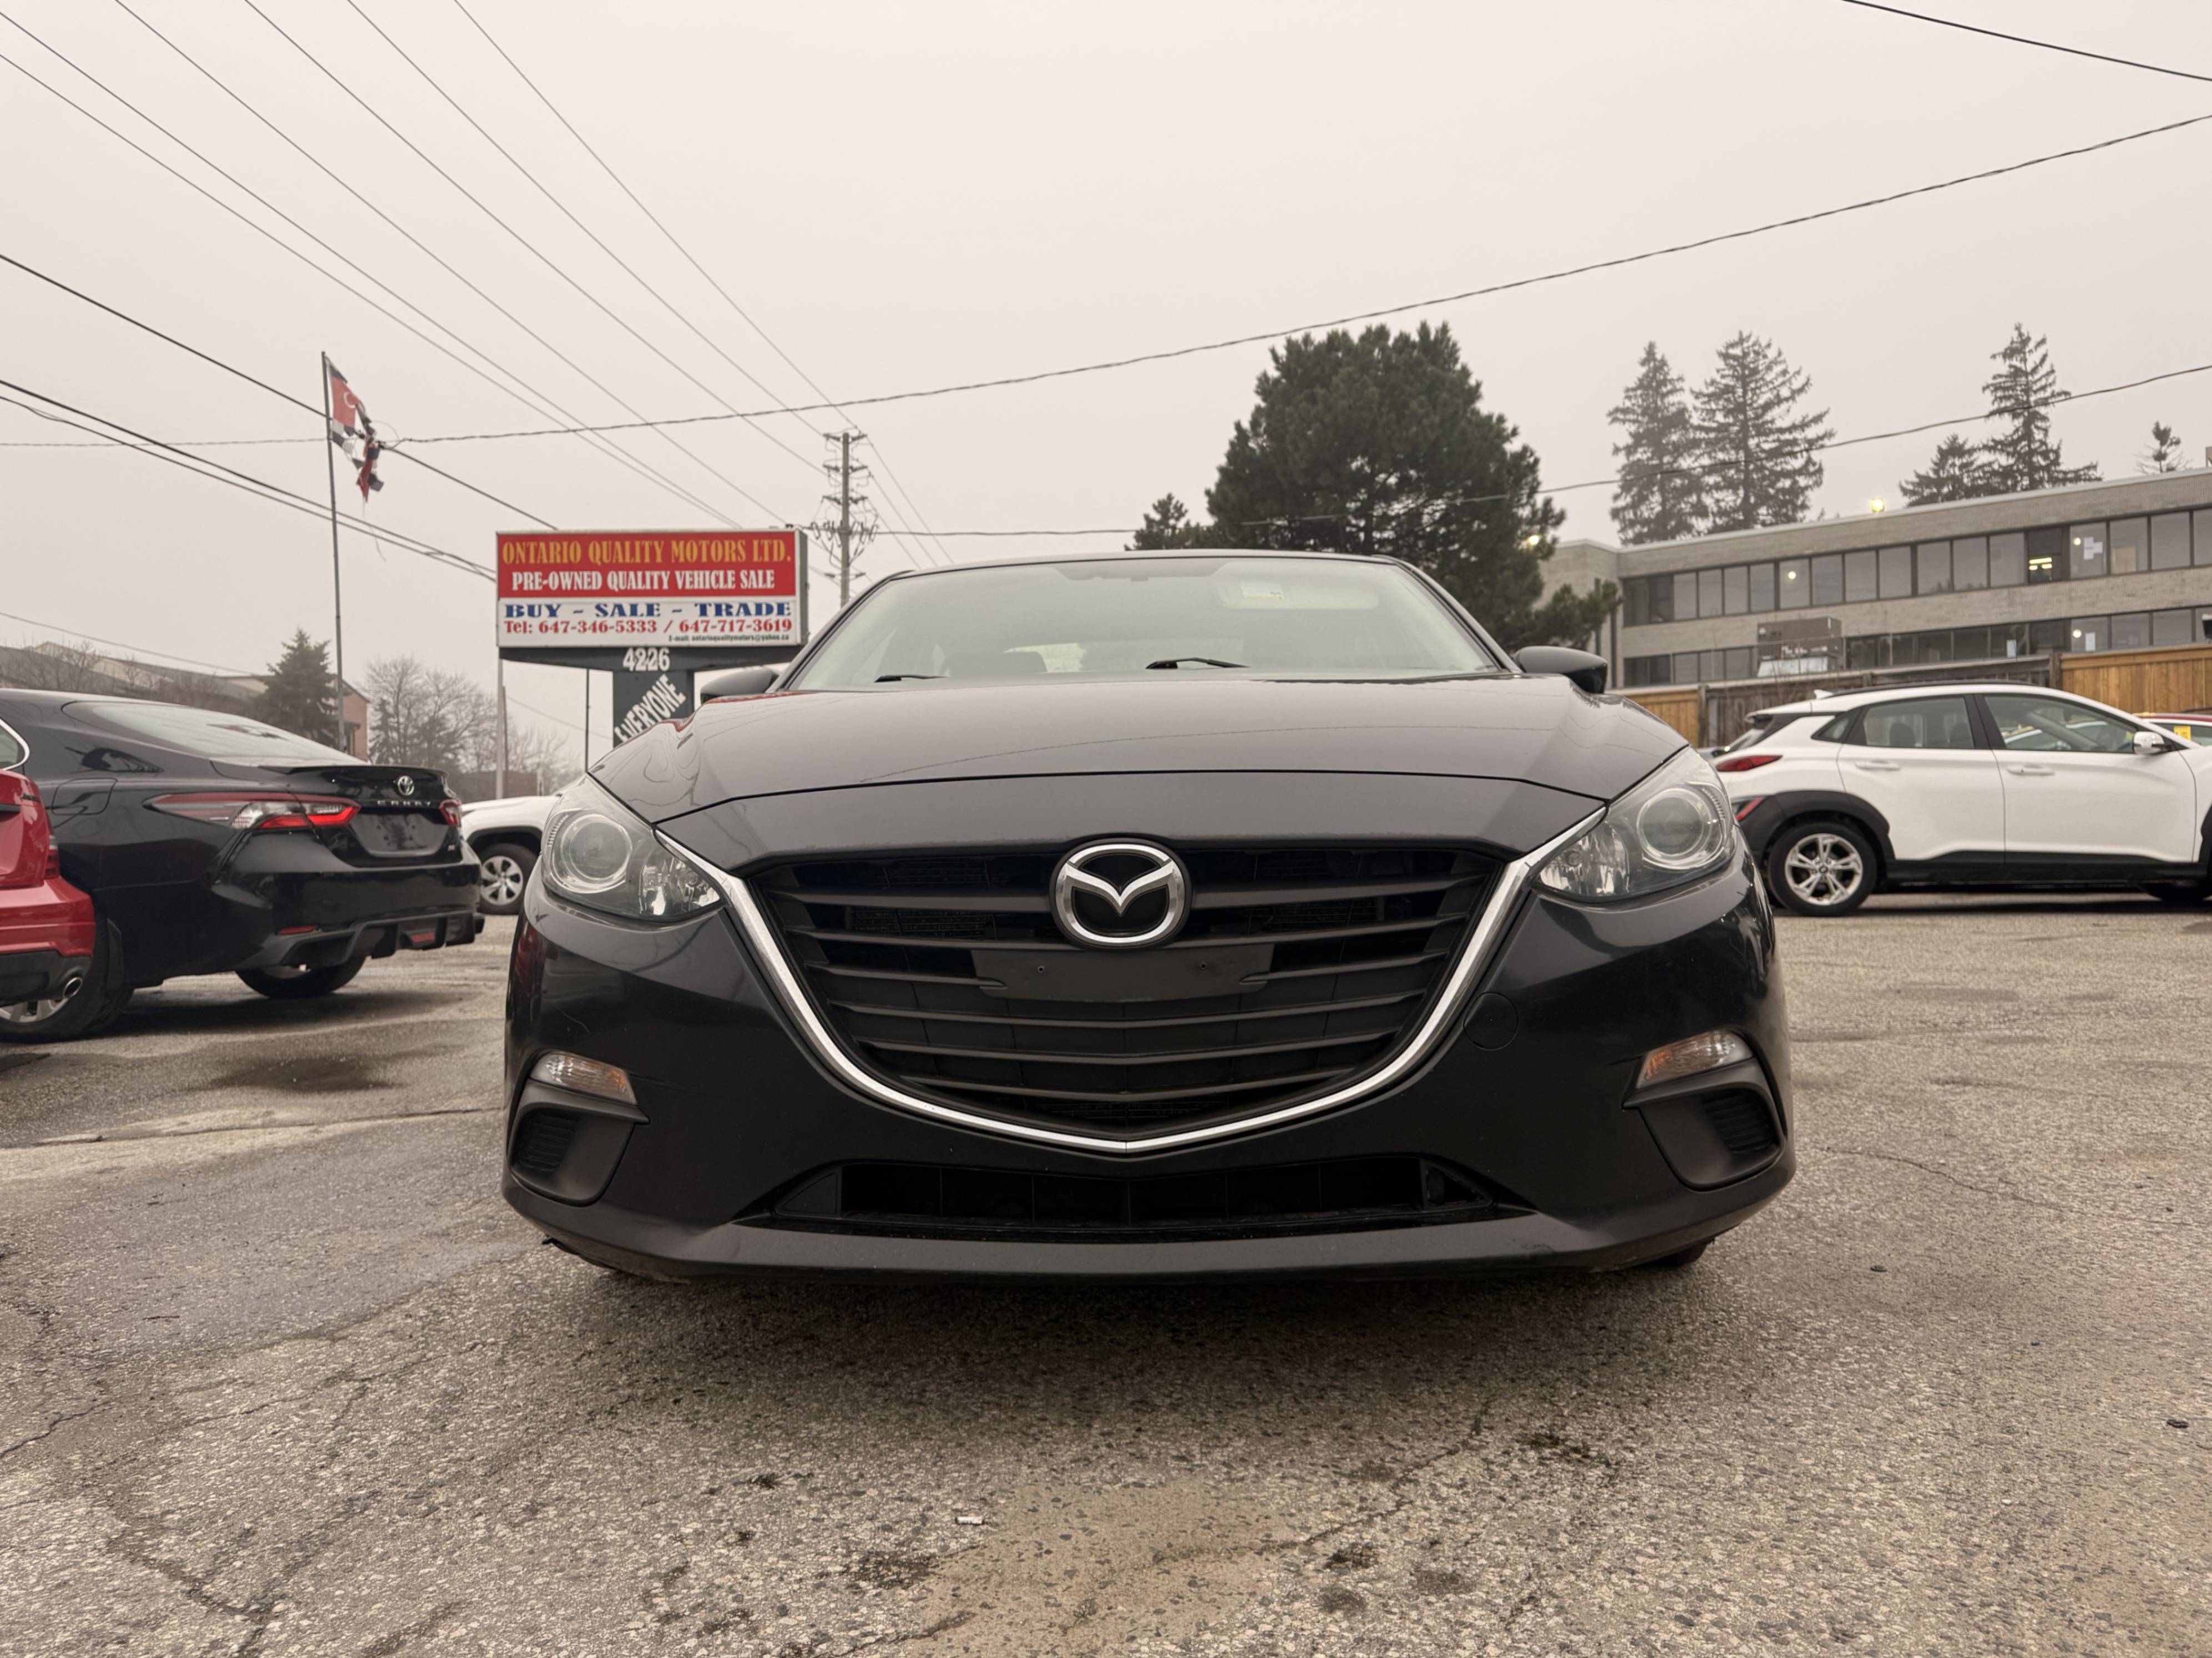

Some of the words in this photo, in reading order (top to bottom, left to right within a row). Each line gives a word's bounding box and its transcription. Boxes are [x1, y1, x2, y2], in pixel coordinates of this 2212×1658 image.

[502, 541, 582, 564] ONTARIO
[588, 540, 665, 566] QUALITY
[671, 539, 747, 563] MOTORS
[752, 539, 791, 563] LTD.
[512, 570, 603, 591] PRE-OWNED
[607, 570, 671, 592] QUALITY
[675, 569, 736, 590] VEHICLE
[740, 569, 775, 589] SALE
[505, 603, 562, 618] BUY
[594, 603, 661, 618] SALE
[694, 602, 792, 617] TRADE
[504, 620, 533, 634] Tel:
[538, 620, 657, 634] 647-346-5333
[663, 619, 674, 633] /
[679, 618, 792, 633] 647-717-3619
[622, 647, 670, 672] 4226
[614, 673, 686, 742] EVERYONE
